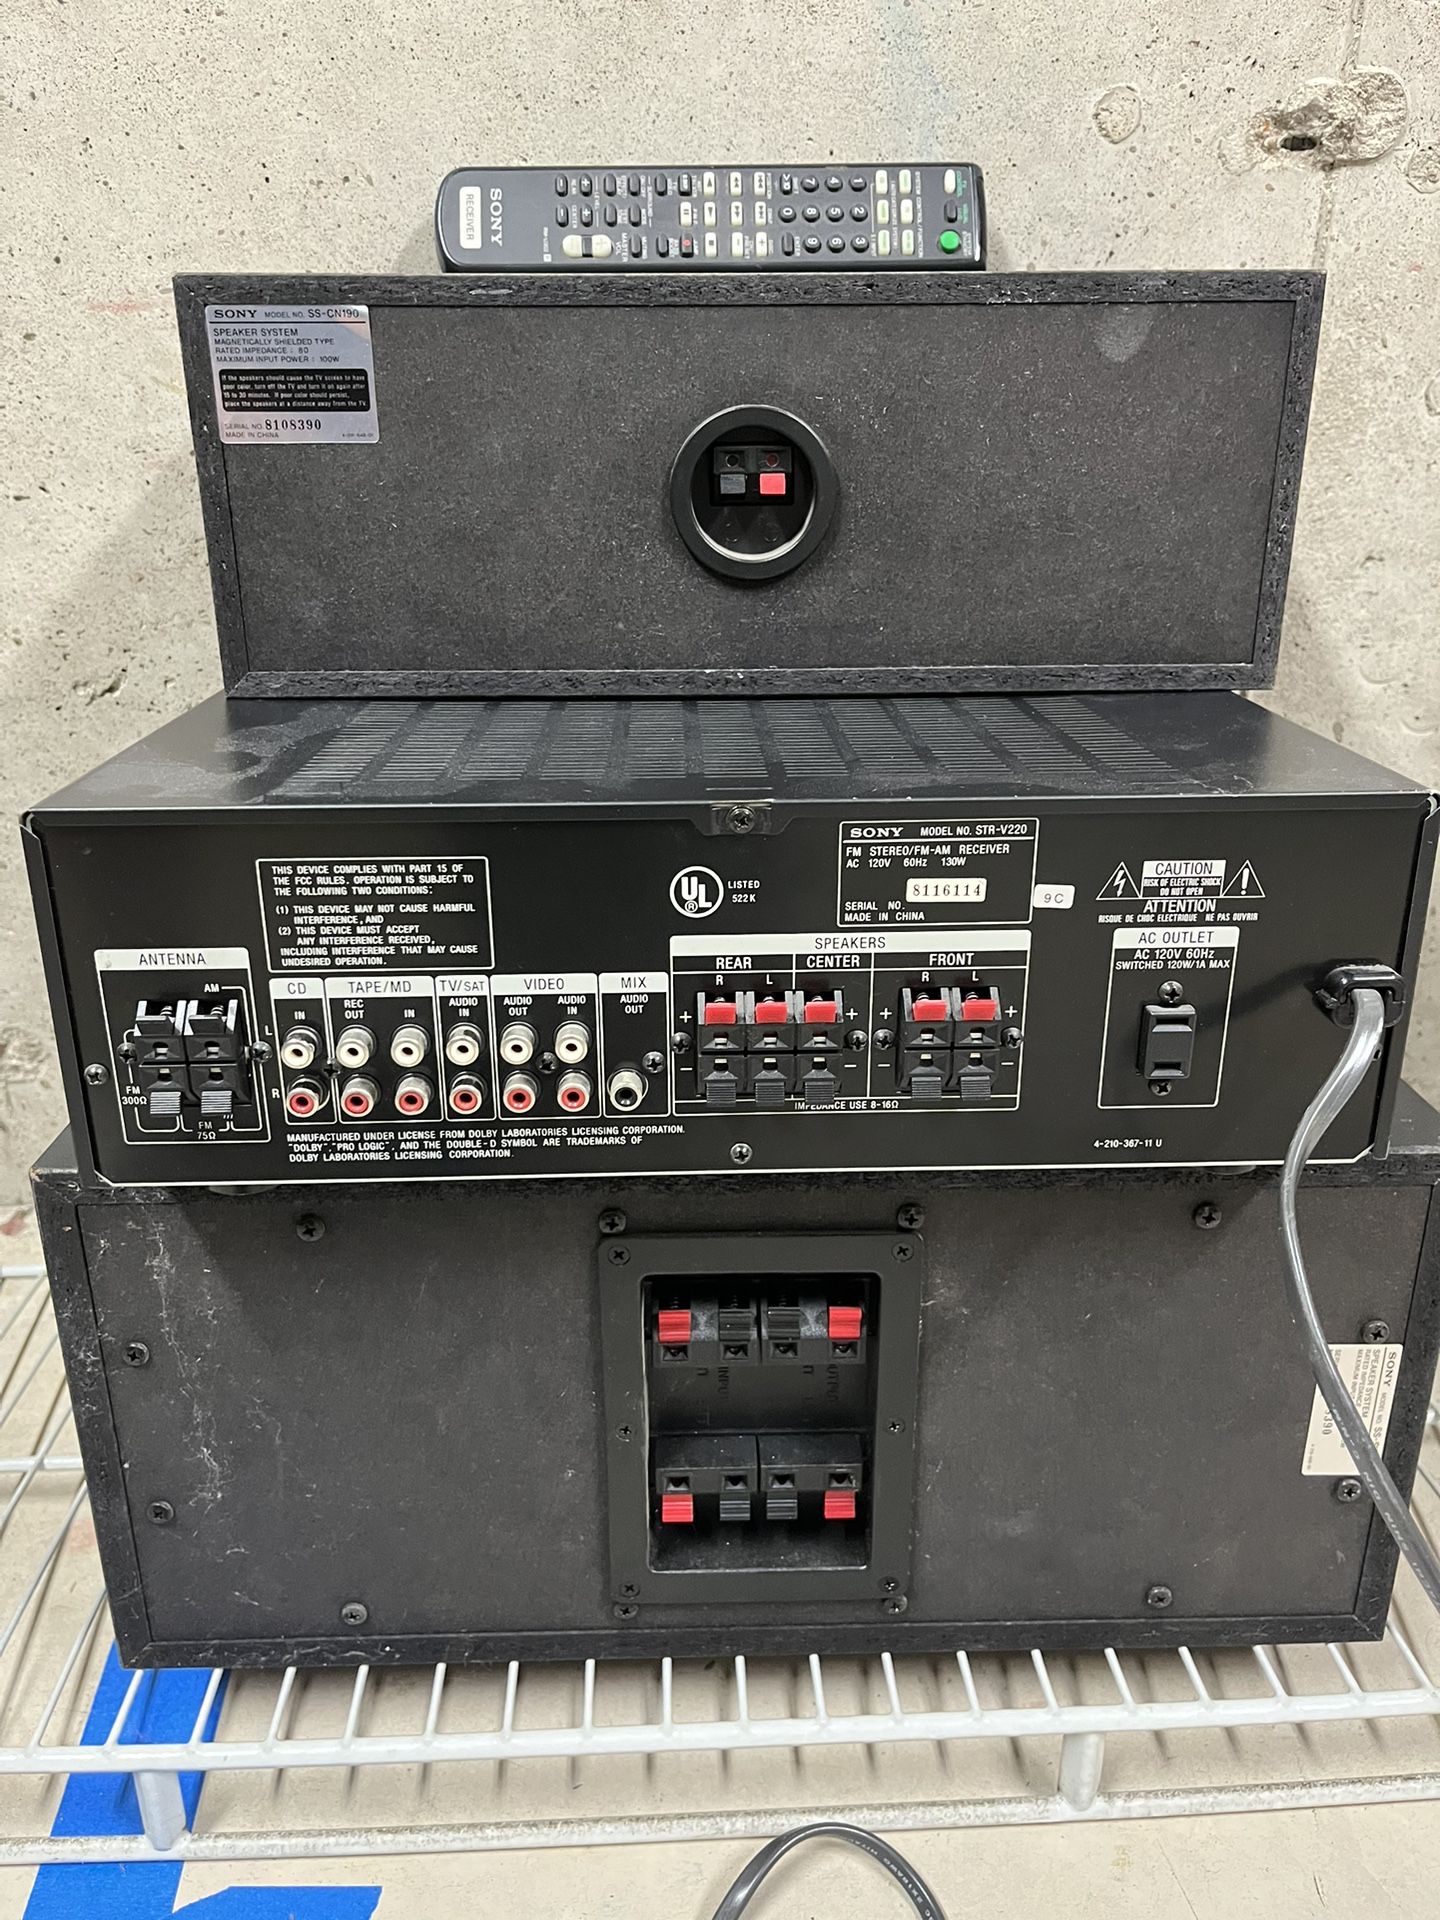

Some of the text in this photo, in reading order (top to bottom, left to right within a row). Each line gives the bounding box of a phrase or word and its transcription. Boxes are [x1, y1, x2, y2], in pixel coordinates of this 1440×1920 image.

[830, 176, 839, 184] 4
[807, 207, 816, 215] 8
[831, 207, 840, 215] 5
[856, 206, 864, 214] 2
[465, 194, 474, 241] RECEIVER
[490, 188, 503, 246] SONY
[807, 237, 817, 245] 9
[831, 237, 841, 245] 6
[856, 237, 865, 245] 3
[214, 310, 257, 318] SONY
[308, 309, 359, 318] SS-CN190
[213, 328, 298, 336] SPEAKER SYSTEM
[265, 419, 321, 430] 8108390
[850, 825, 1027, 838] SONY MODEL NO. STR-V220
[846, 844, 1009, 856] FM STEREO/FM-AM RECEIVER
[846, 857, 966, 868] AC 120V 60Hz 130W
[272, 864, 463, 874] THIS DEVICE COMPLIES WITH PART 15 OF
[1156, 862, 1213, 875] CAUTION
[273, 877, 291, 885] THE
[295, 877, 312, 885] FCC
[317, 876, 349, 884] RULES.
[354, 876, 402, 884] OPERATION
[405, 875, 414, 883] IS
[419, 875, 457, 883] SUBJECT
[274, 886, 433, 896] THE FOLLOWING TWO CONDITIONS:
[913, 884, 981, 896] 8116114
[276, 904, 476, 914] (1) THIS DEVICE MAY NOT CAUSE HARMFUL
[845, 901, 905, 910] SERIAL NO.
[1143, 899, 1216, 913] ATTENTION
[845, 912, 925, 921] MADE IN CHINA
[1138, 931, 1214, 944] AC OUTLET
[815, 937, 886, 949] SPEAKERS
[139, 953, 206, 965] ANTENNA
[1134, 949, 1215, 959] AC 120V 60Hz
[716, 957, 751, 969] REAR
[807, 955, 860, 968] CENTER
[929, 953, 974, 966] FRONT
[1116, 960, 1230, 970] SWITCHED 120W/1A MAX
[716, 975, 723, 985] R
[766, 974, 773, 984] L
[922, 972, 929, 981] R
[972, 971, 979, 981] L
[348, 981, 411, 993] TAPE/MD
[439, 980, 484, 992] TV/SAT
[524, 978, 564, 990] VIDEO
[621, 977, 646, 988] MIX
[204, 984, 219, 993] AM
[287, 983, 307, 994] CD
[344, 1000, 364, 1008] REC
[449, 997, 478, 1006] AUDIO
[504, 997, 532, 1005] AUDIO
[558, 996, 586, 1004] AUDIO
[620, 995, 648, 1003] AUDIO
[345, 1010, 364, 1018] OUT
[459, 1008, 469, 1016] IN
[509, 1007, 528, 1015] OUT
[567, 1006, 577, 1015] IN
[625, 1005, 644, 1014] OUT
[265, 1025, 272, 1035] L
[126, 1086, 140, 1094] FM
[272, 1088, 280, 1098] R
[122, 1097, 147, 1105] 300Ω
[850, 1101, 867, 1109] USE
[197, 1131, 216, 1140] 75Ω
[287, 1125, 685, 1142] MANUFACTURED UNDER LICENSE FROM DOLBY LABORATORIES LICENSING CORPORATION.
[423, 1141, 441, 1149] THE
[501, 1139, 537, 1147] SYMBOL
[543, 1138, 560, 1146] ARE
[567, 1137, 626, 1145] TRADEMARKS
[631, 1136, 643, 1144] OF
[1094, 1139, 1162, 1147] 4-210-367-11 U
[1384, 1352, 1396, 1386] SONY
[1362, 1349, 1380, 1417] SPEAKER SYSTEM
